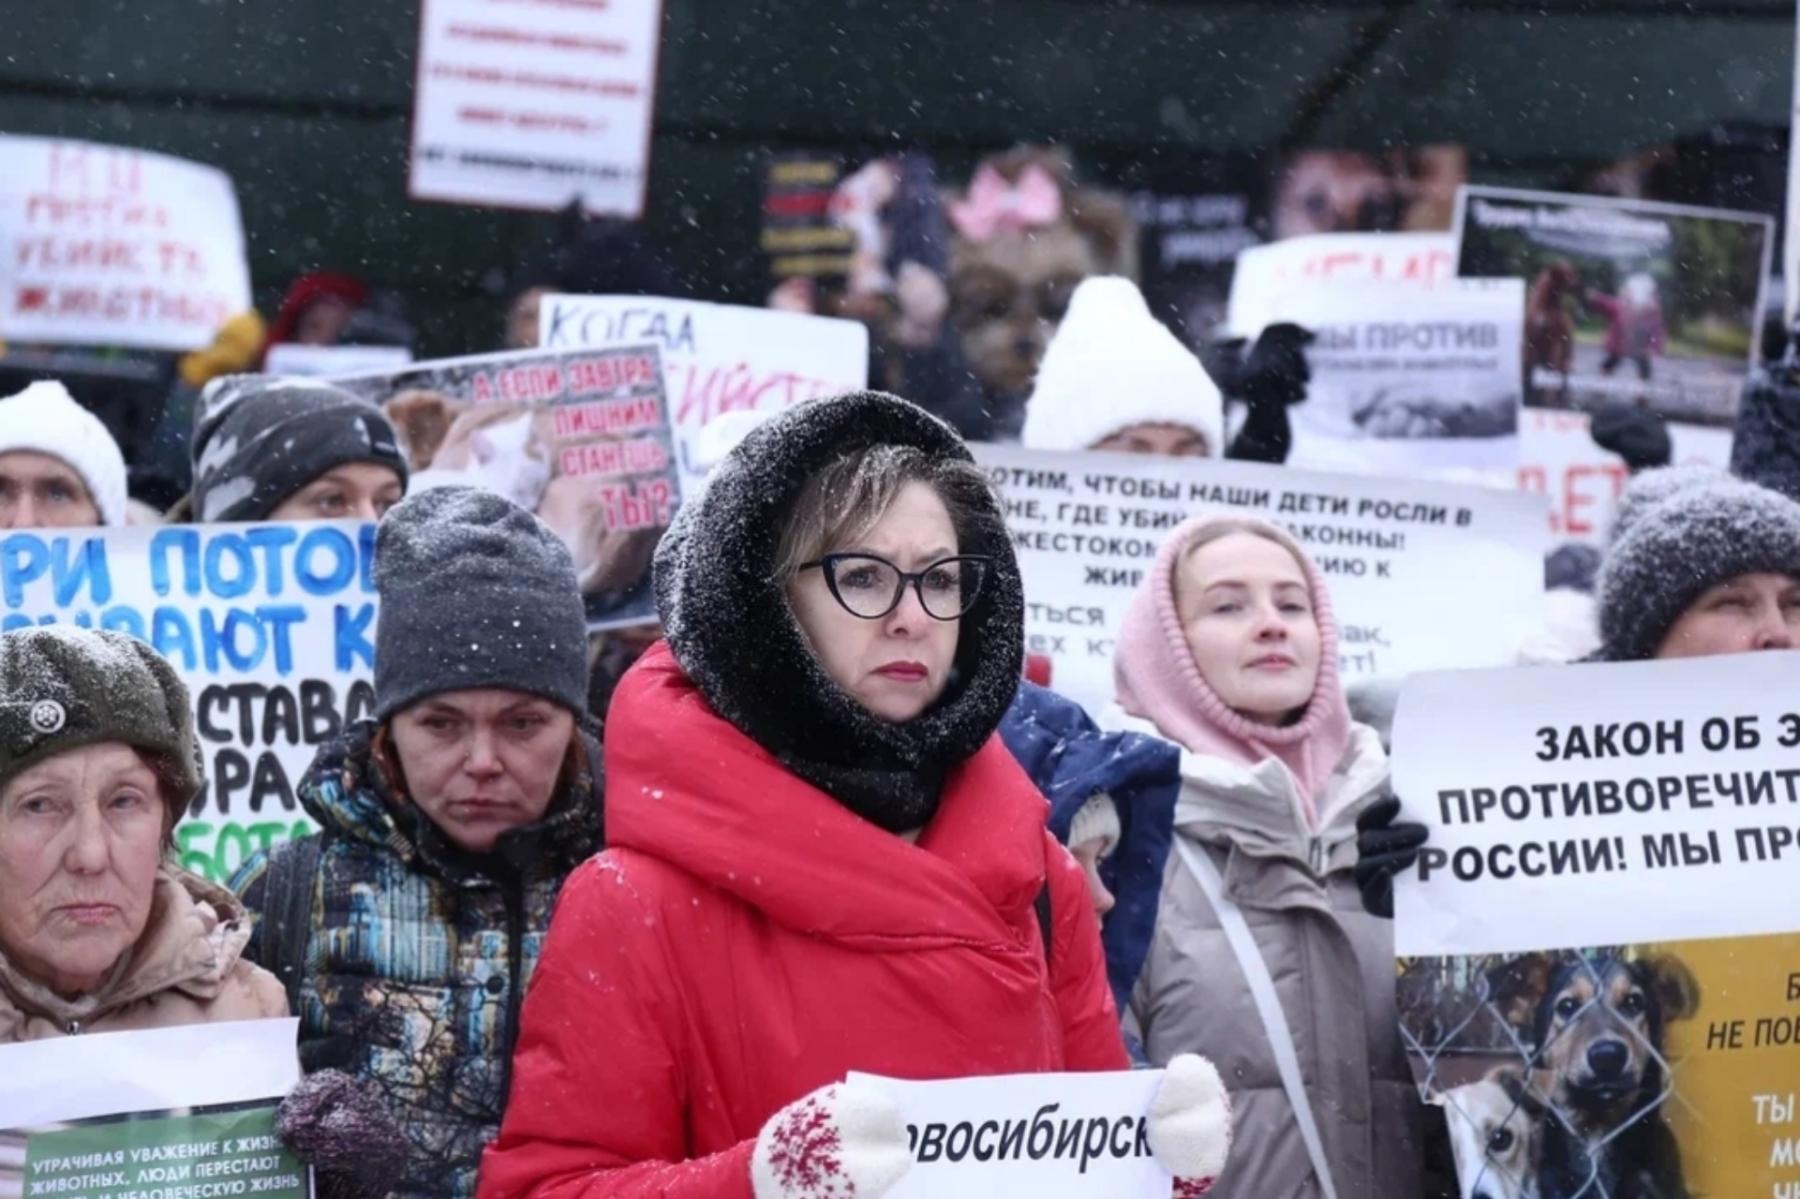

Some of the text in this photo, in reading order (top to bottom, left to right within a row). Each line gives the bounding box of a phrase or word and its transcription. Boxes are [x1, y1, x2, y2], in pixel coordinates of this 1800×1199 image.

[1366, 321, 1498, 351] ПРОТИВ
[474, 372, 492, 400] А
[570, 356, 653, 391] ЗАВТРА
[668, 362, 848, 425] ИЙСТ
[600, 480, 671, 529] ТЫ?
[982, 467, 1473, 527] ОТИМ, ЧТОБЫ НАШИ ДЕТИ РОСЛИ В
[1057, 503, 1109, 526] ГДЕ
[1285, 521, 1405, 549] АКОННЫ!
[1315, 556, 1367, 577] ИЮ
[1376, 560, 1392, 580] К
[1, 604, 307, 676] АЮТ
[1535, 719, 1684, 762] ЗАКОН
[1701, 715, 1761, 752] ОБ
[1437, 768, 1800, 825] ПРОТИВОРЕЧИТ
[1416, 825, 1800, 884] РОССИИ! МЫ ПР
[1707, 1020, 1745, 1050] НЕ
[1753, 1093, 1795, 1124] ТЫ
[32, 1134, 284, 1175] УТРАЧИВАЯ УВАЖЕНИЕ К ЖИЗН
[1769, 1137, 1800, 1168] М
[30, 1155, 280, 1196] ЖИВОТНЫХ. ЛЮДИ ПЕРЕСТАЮТ
[250, 1173, 300, 1193] ЖИЗНЬ
